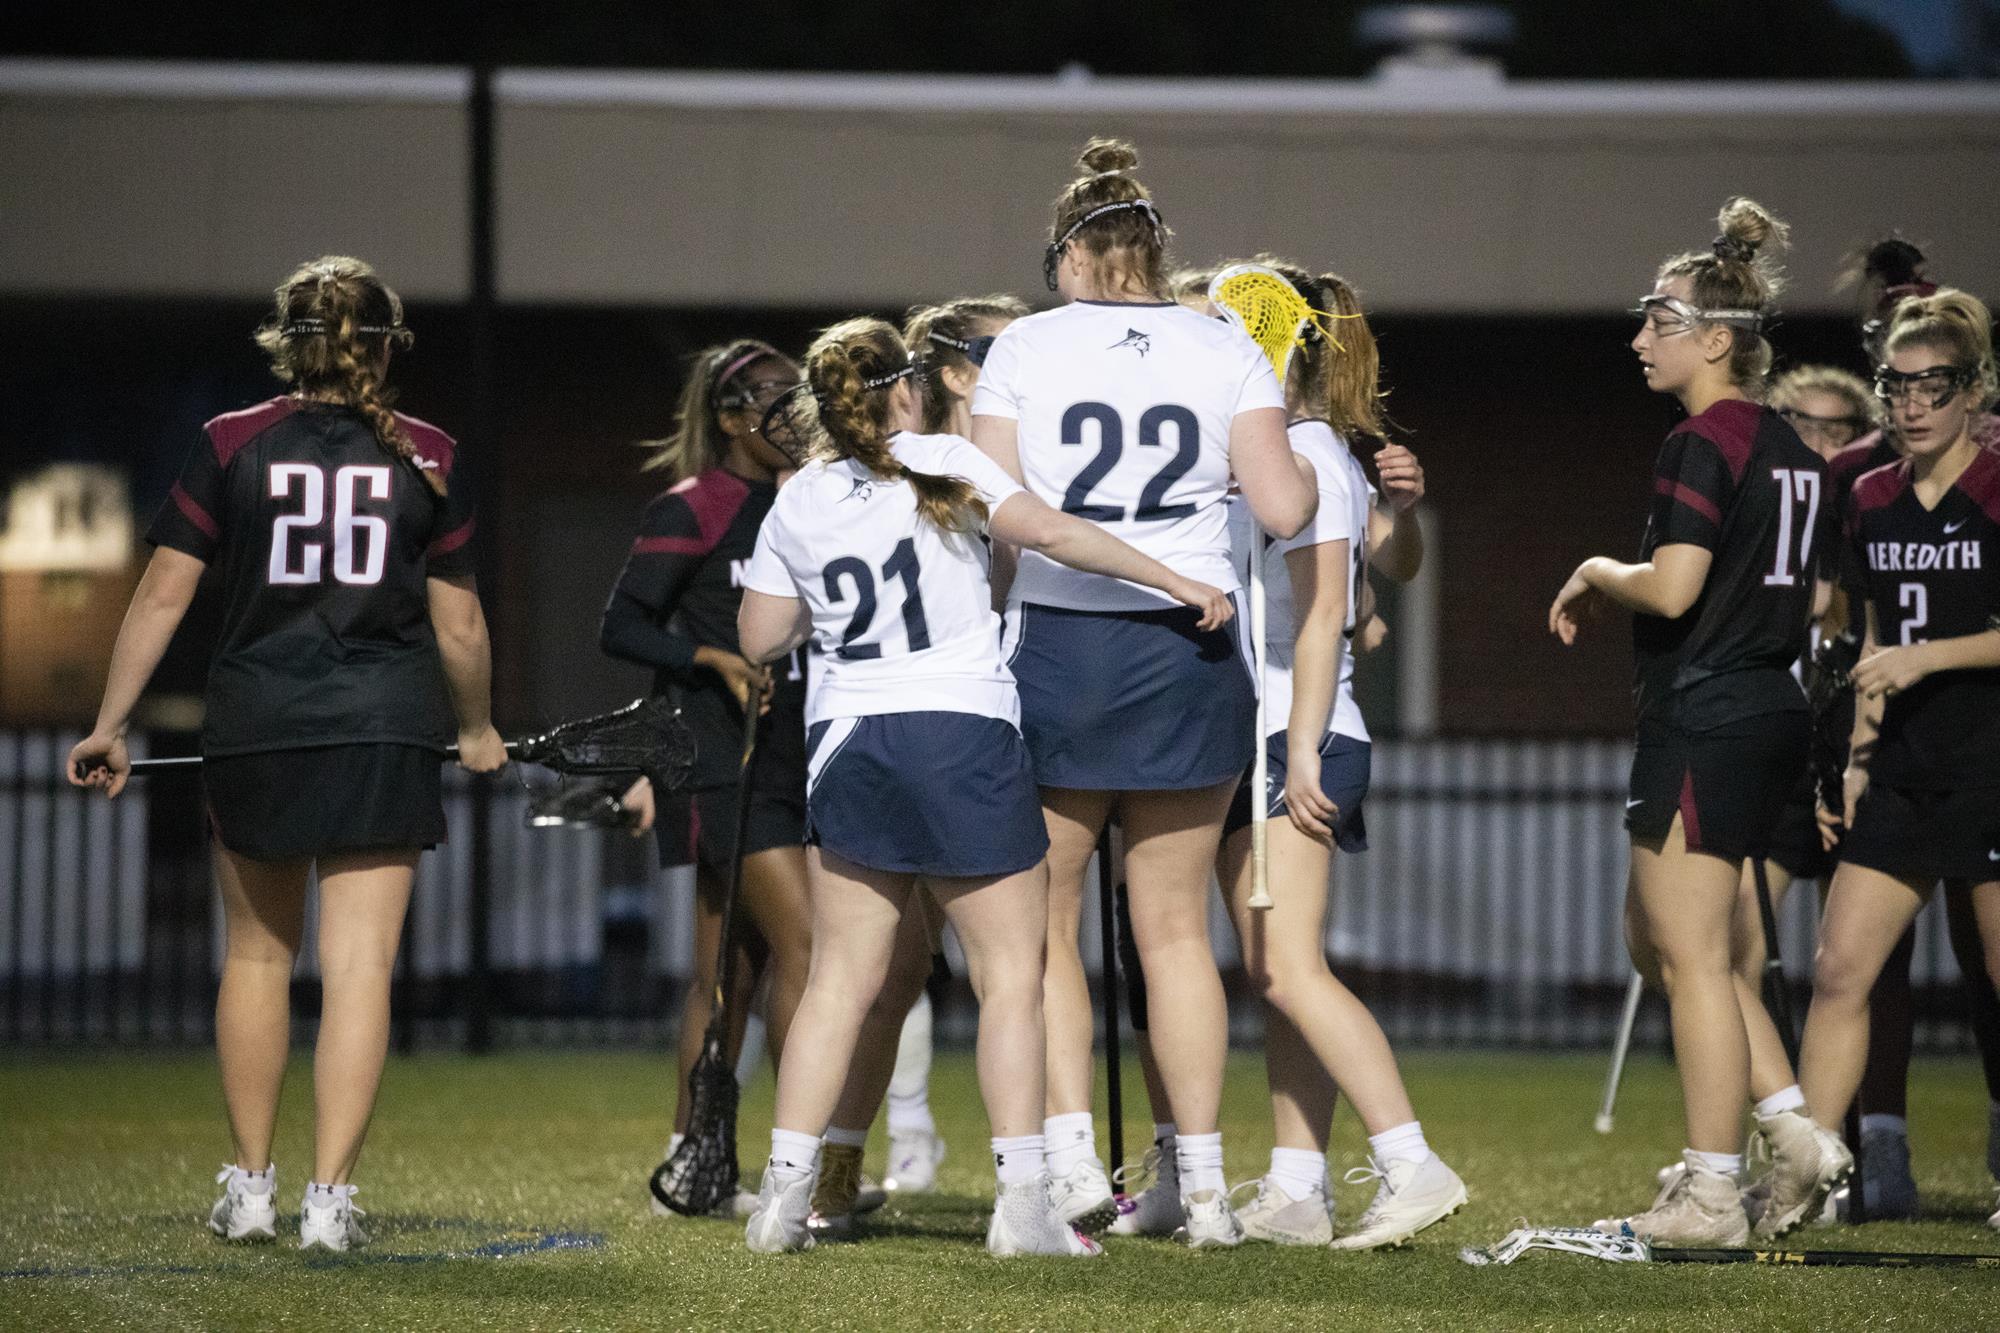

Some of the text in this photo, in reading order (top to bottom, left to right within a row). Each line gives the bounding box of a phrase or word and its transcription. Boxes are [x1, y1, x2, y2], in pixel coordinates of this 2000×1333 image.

[1084, 202, 1131, 221] ARMOUR
[1061, 401, 1200, 522] 22
[268, 463, 391, 585] 26
[1764, 469, 1820, 586] 17
[822, 537, 931, 660] 21
[1899, 583, 1927, 646] 2
